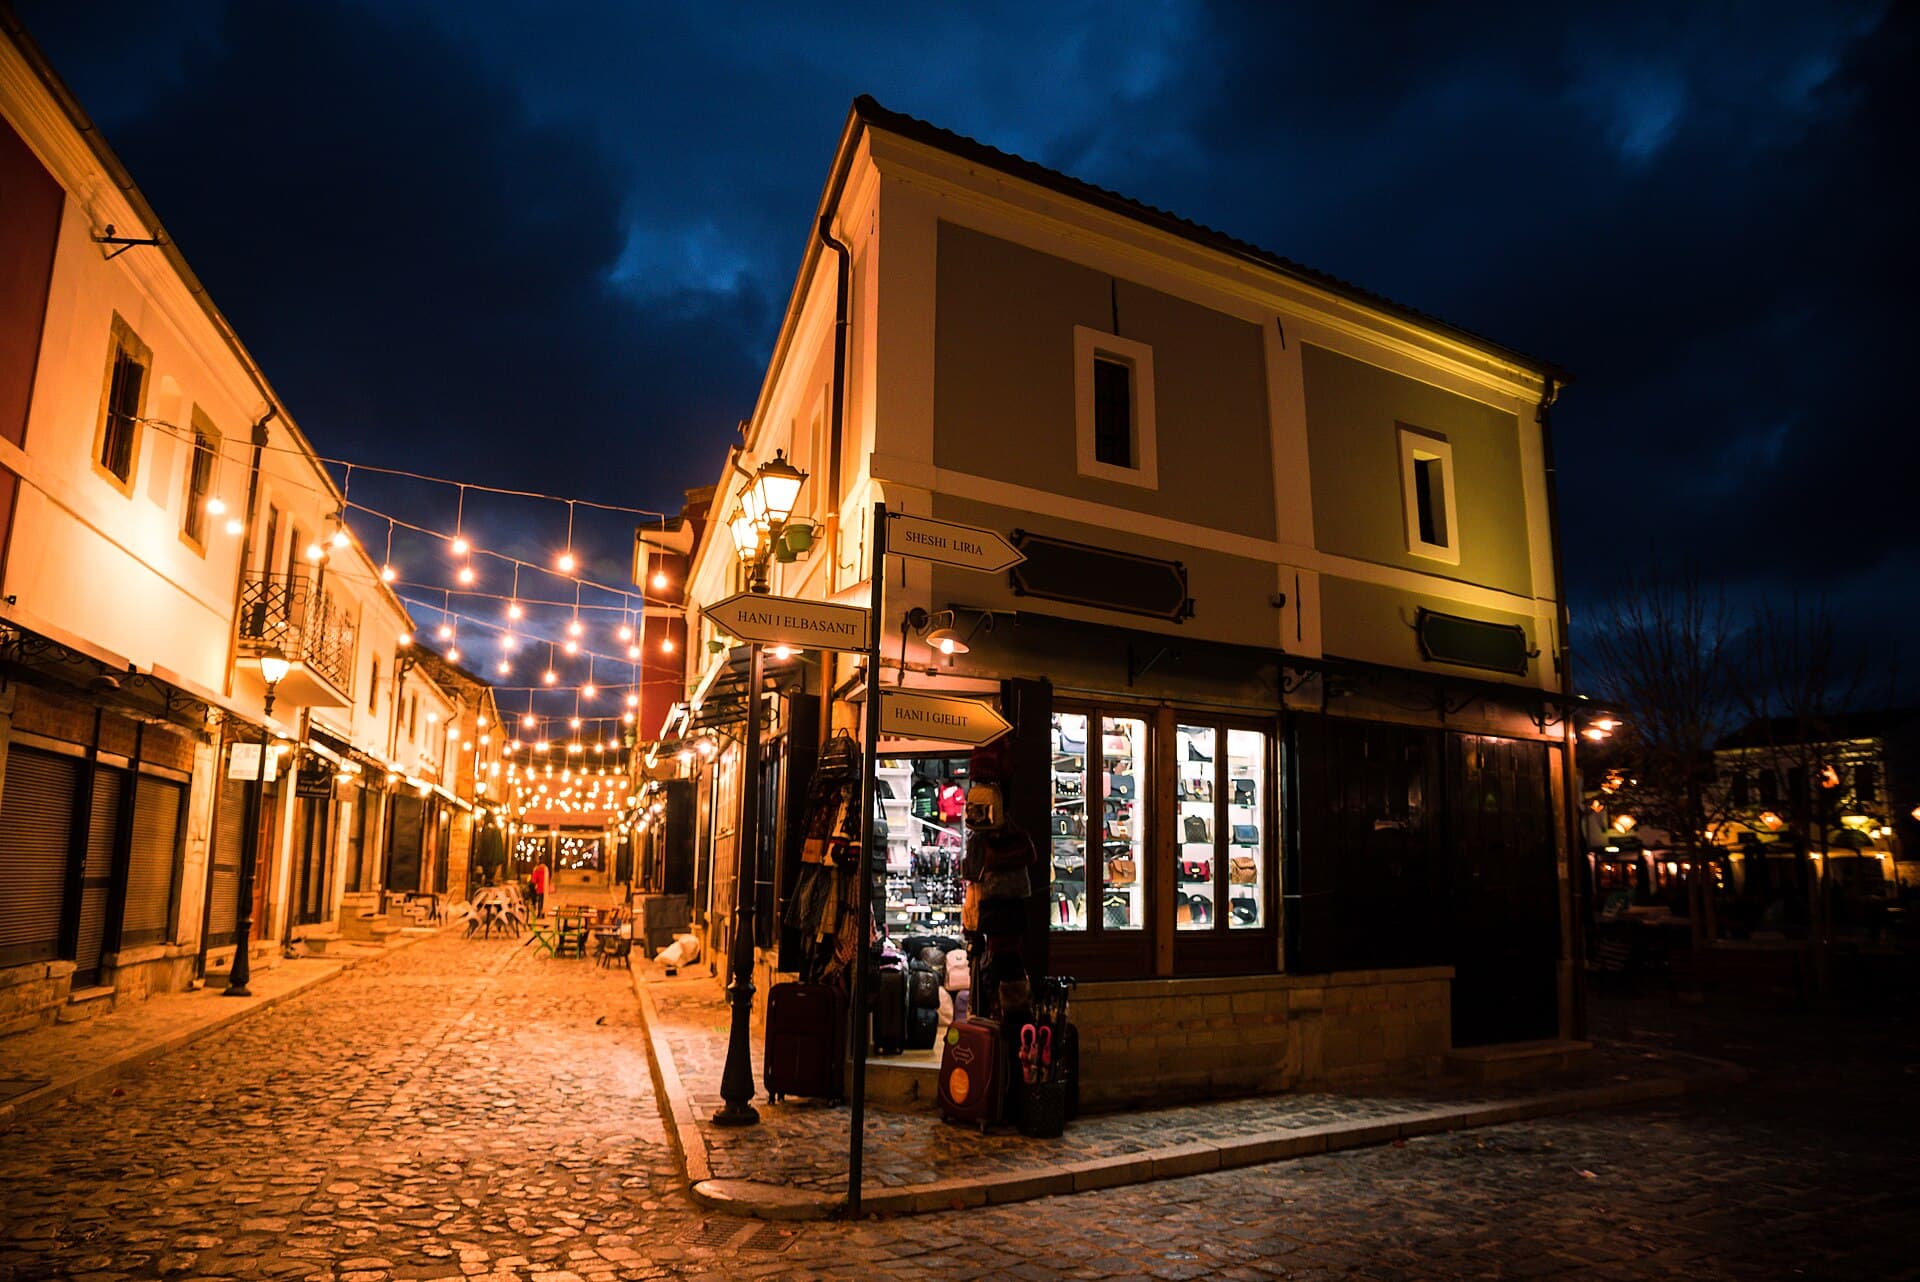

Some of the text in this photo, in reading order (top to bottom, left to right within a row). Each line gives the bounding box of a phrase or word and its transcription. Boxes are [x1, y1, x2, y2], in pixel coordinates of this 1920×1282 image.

[905, 530, 984, 556] SHESHI LIRIA
[738, 610, 773, 626] HANI
[784, 616, 858, 635] ELBASANIT
[895, 707, 923, 721] HANI
[932, 712, 968, 727] GJELIT
